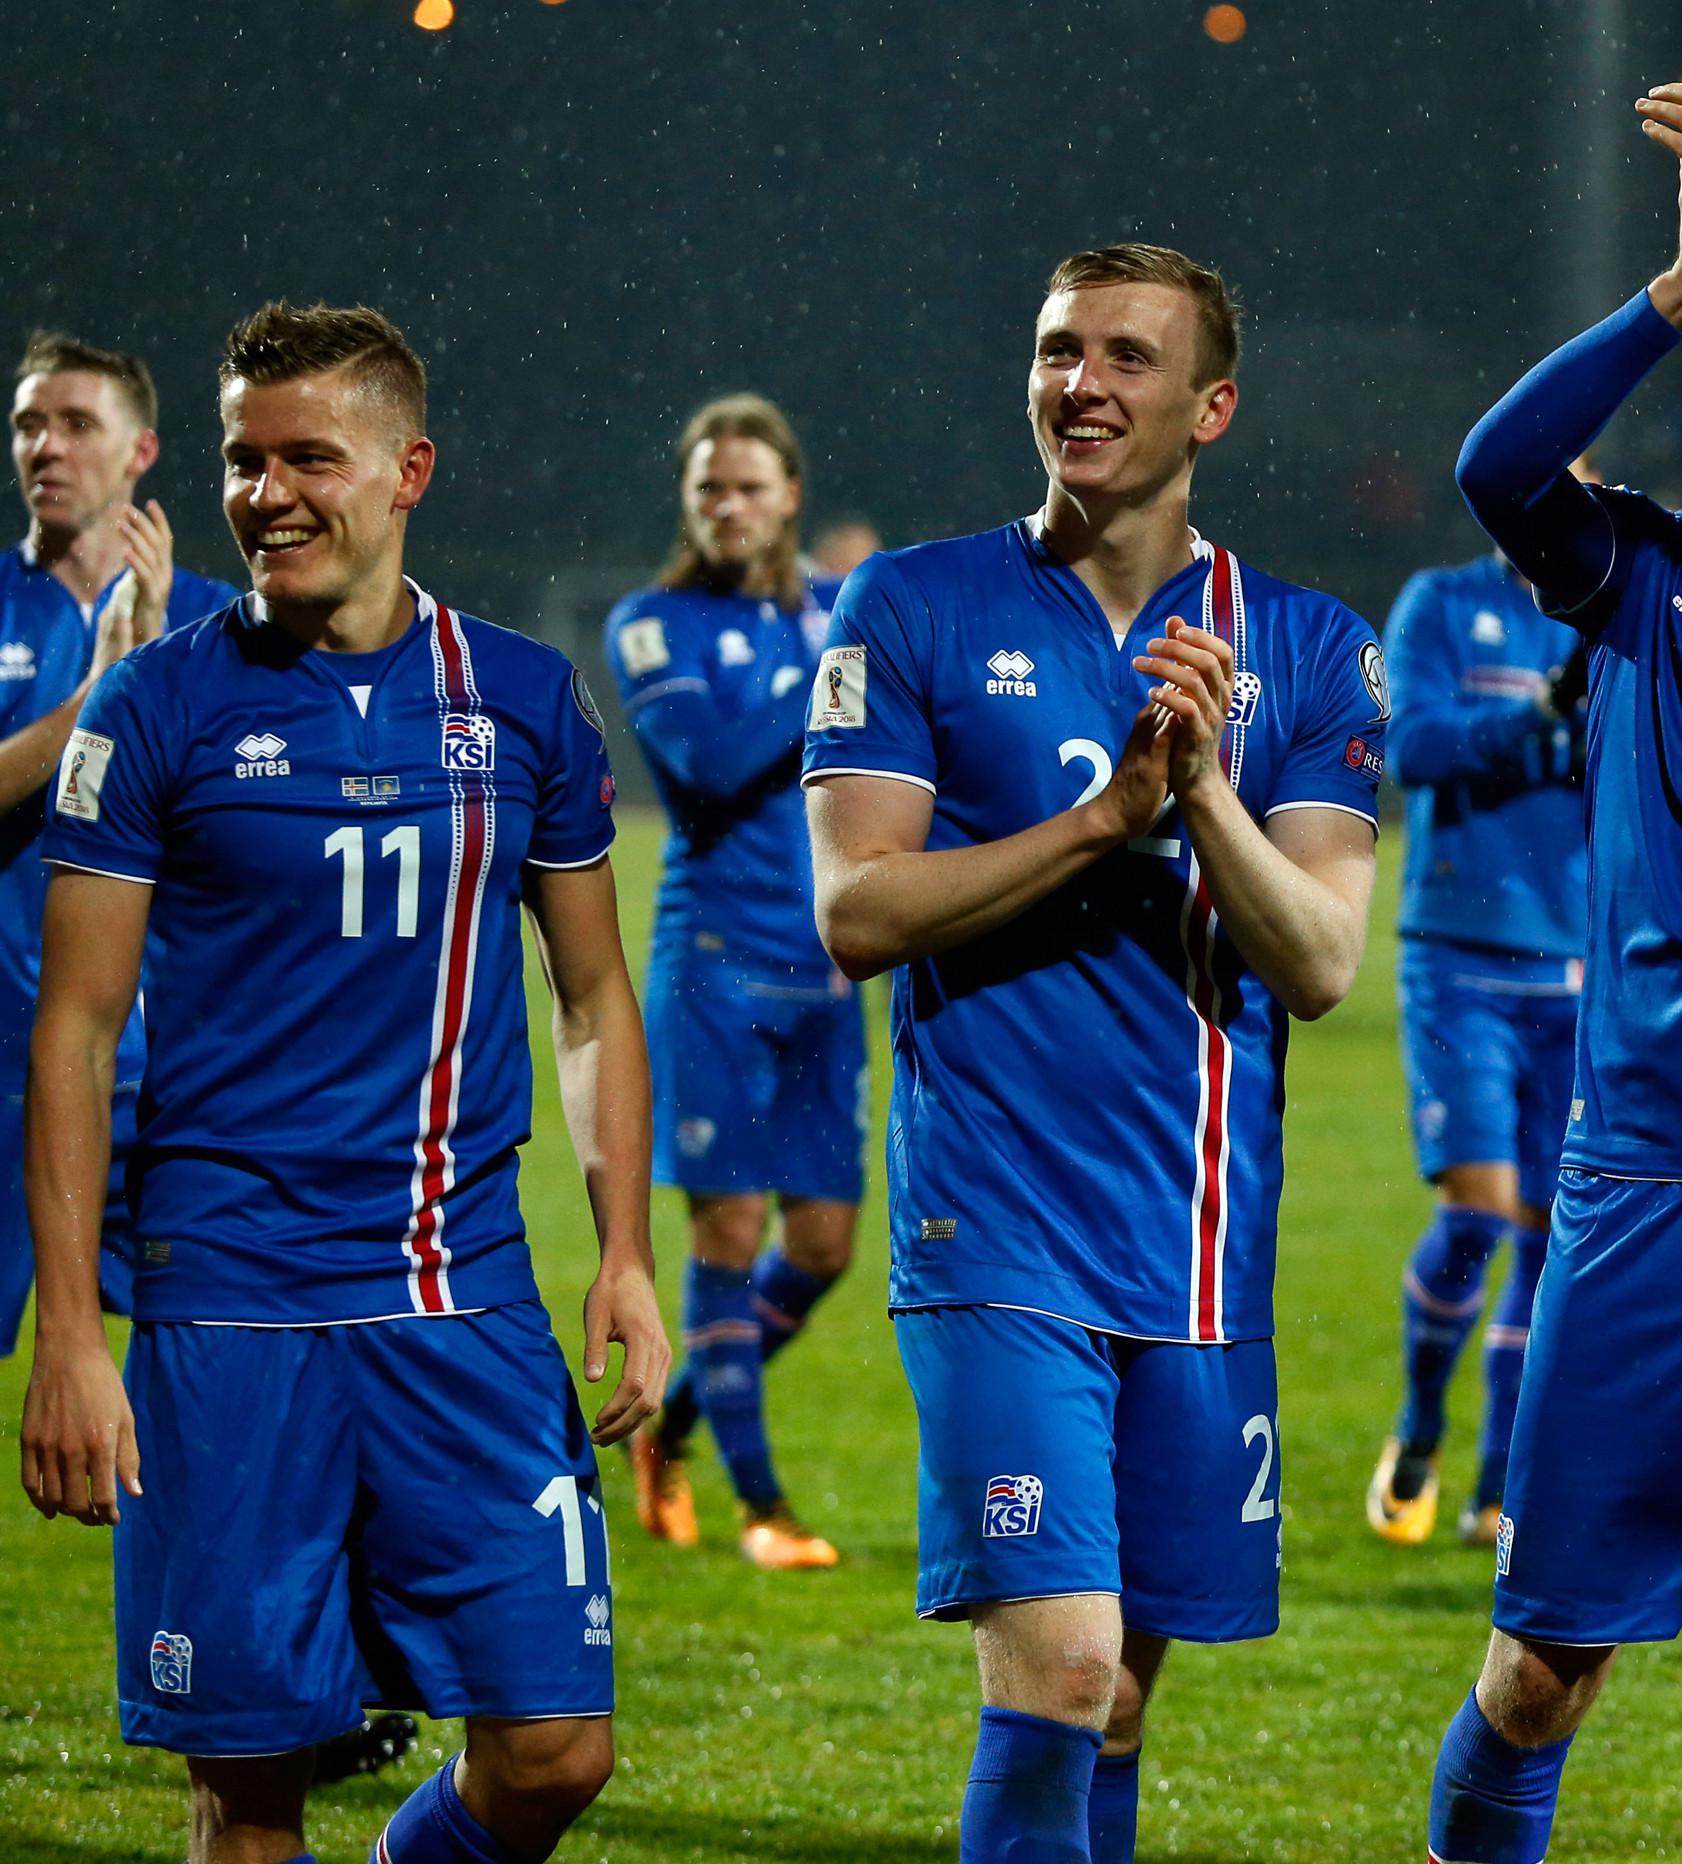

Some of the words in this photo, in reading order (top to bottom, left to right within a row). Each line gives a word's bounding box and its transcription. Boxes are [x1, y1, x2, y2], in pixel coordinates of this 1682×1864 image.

[986, 679, 1037, 697] errea
[1226, 694, 1255, 723] SI
[234, 758, 291, 779] errea
[444, 742, 493, 769] KSI
[324, 825, 421, 938] 11
[1241, 1414, 1282, 1523] 2
[984, 1504, 1038, 1536] KSI
[1497, 1545, 1510, 1573] SI
